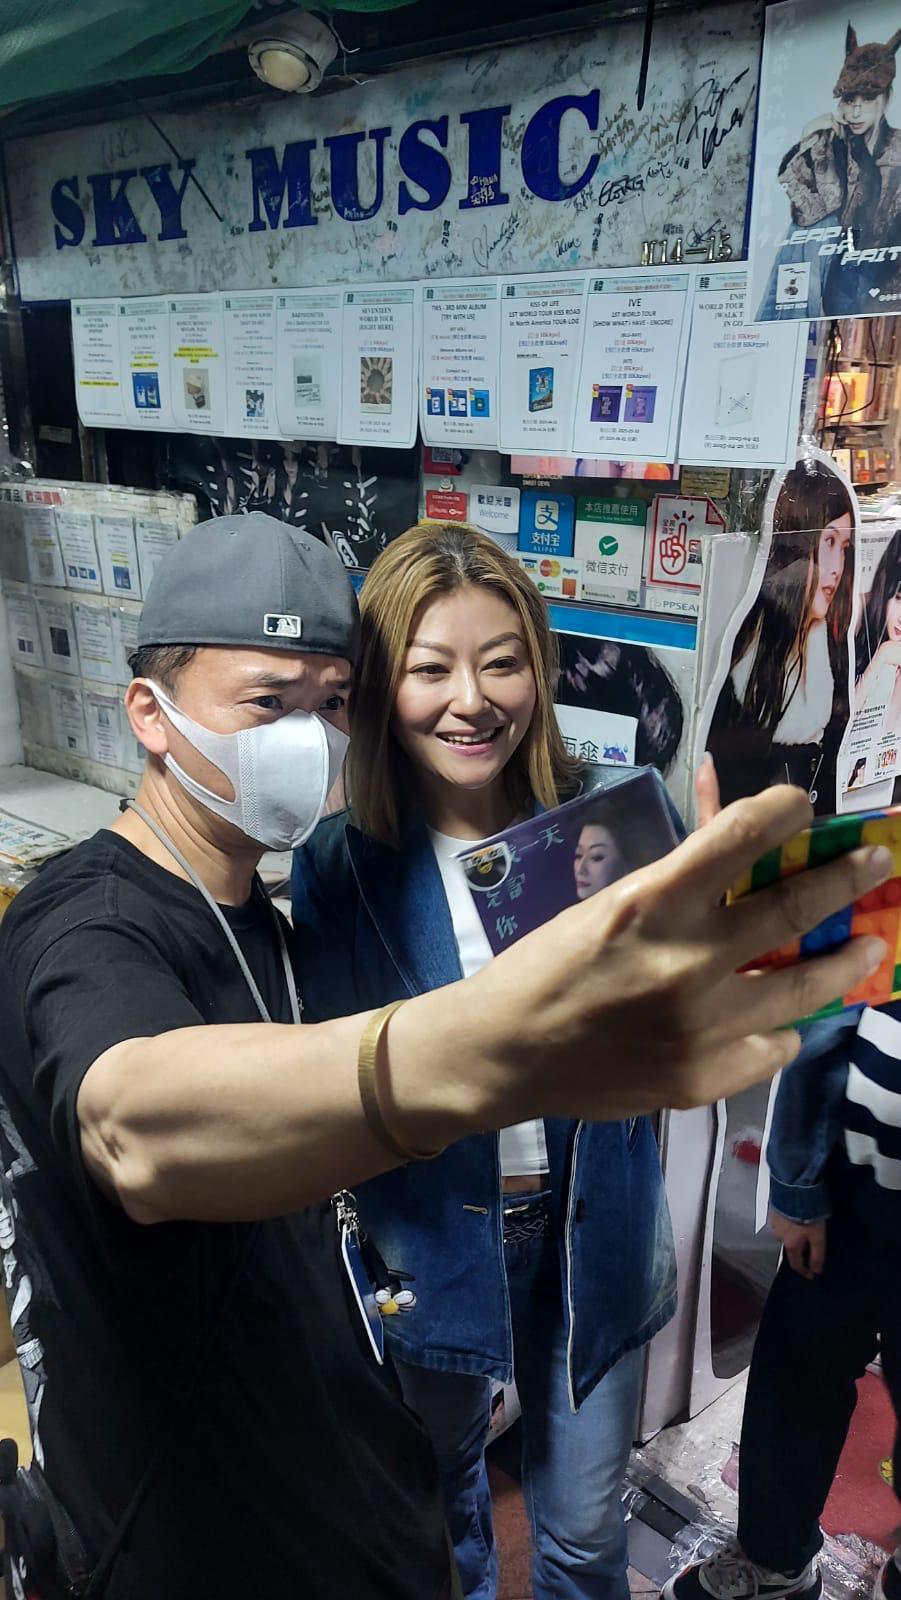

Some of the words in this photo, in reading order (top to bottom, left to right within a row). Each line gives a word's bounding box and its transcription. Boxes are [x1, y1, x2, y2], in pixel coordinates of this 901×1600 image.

[51, 159, 196, 250] SKY
[245, 88, 600, 232] MUSIC
[628, 298, 642, 307] IVE
[480, 509, 510, 520] Welcome
[531, 531, 560, 547] 支付宝
[533, 545, 558, 553] ALIPAY
[563, 567, 579, 575] PayPal
[586, 560, 629, 577] 微信支付
[495, 914, 519, 940] 你
